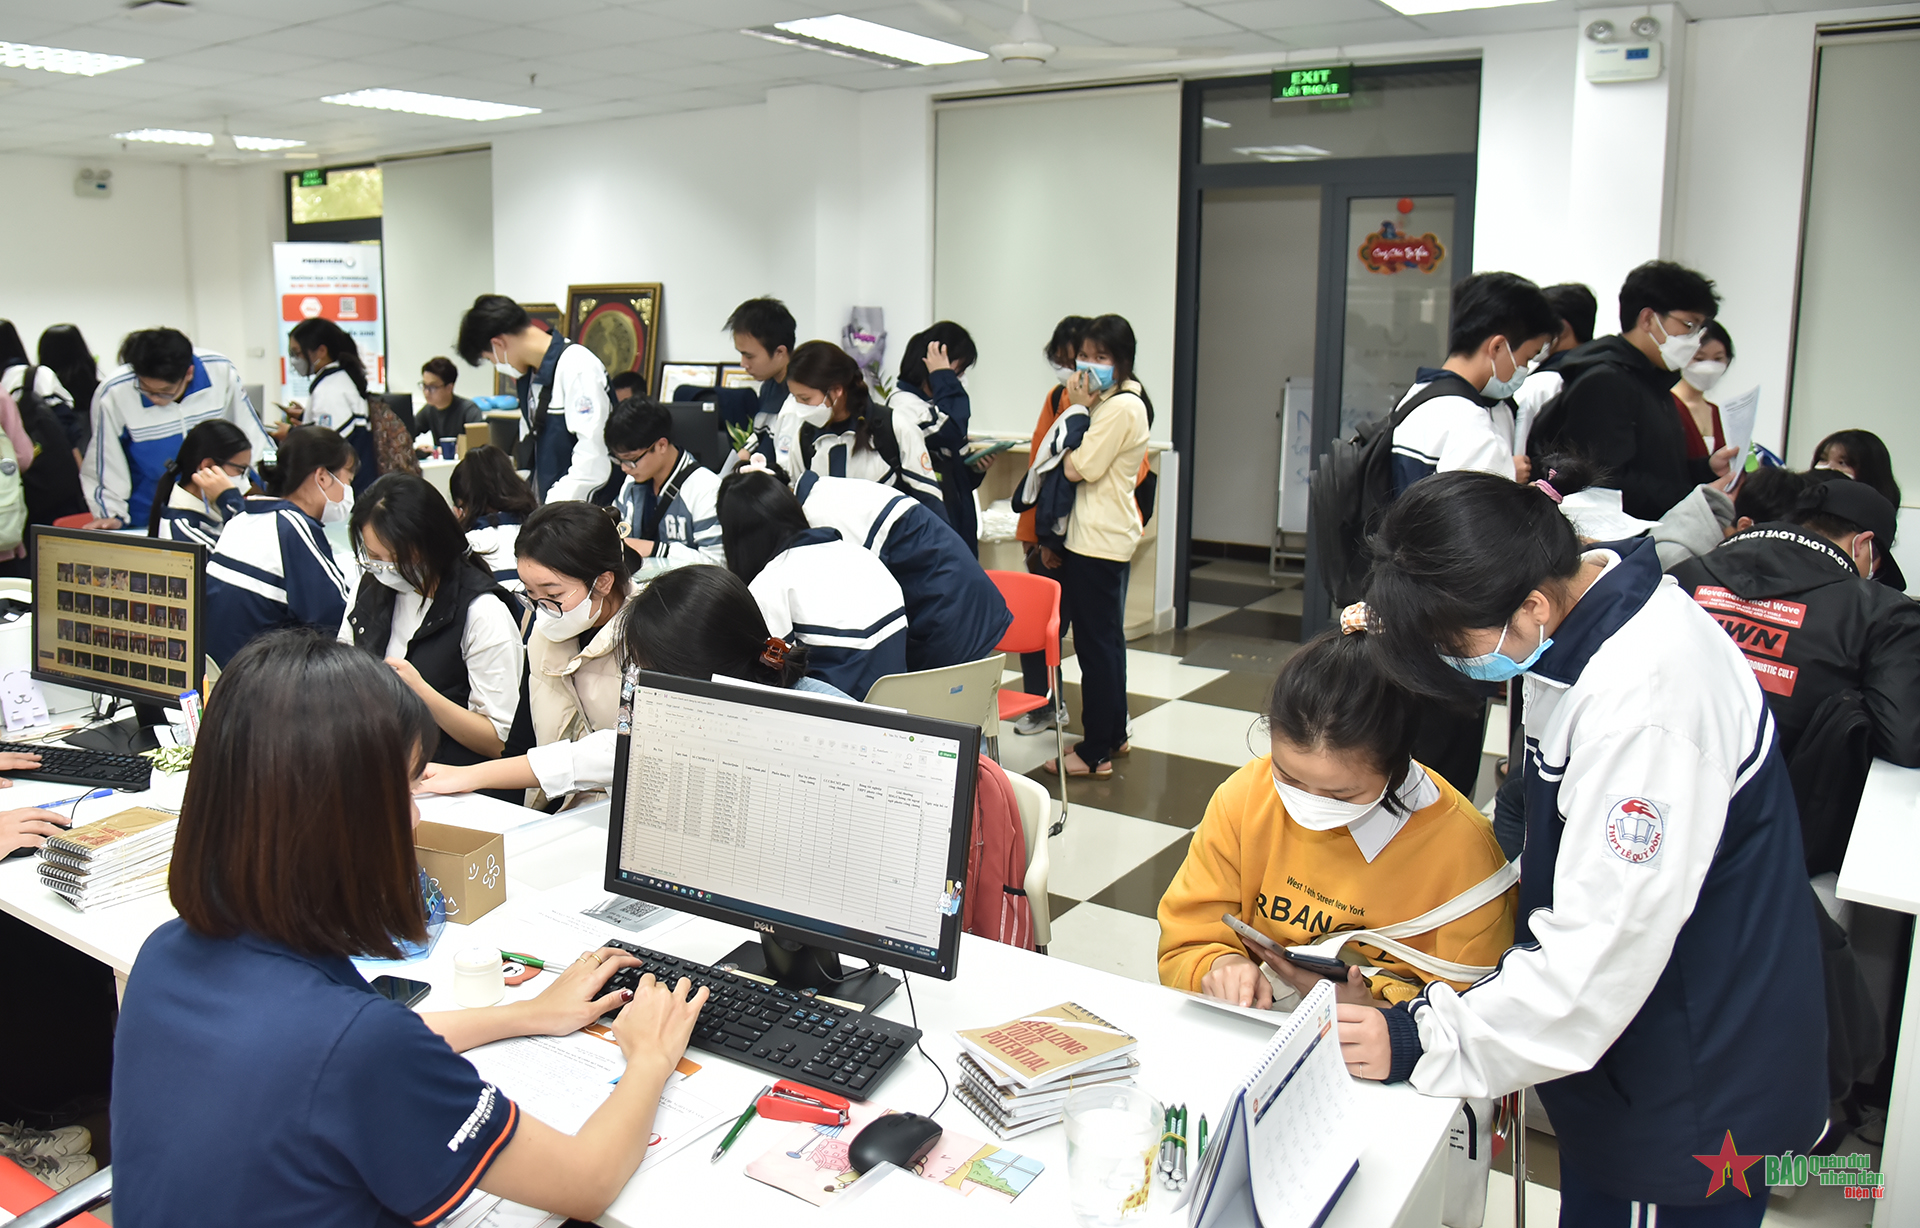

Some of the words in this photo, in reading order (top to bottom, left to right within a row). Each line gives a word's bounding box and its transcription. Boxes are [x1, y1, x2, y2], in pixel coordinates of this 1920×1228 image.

[1290, 69, 1332, 85] EXIT
[1766, 529, 1796, 542] LOVE
[1797, 534, 1826, 553] LOVE
[1827, 547, 1849, 570] LOVE
[1773, 602, 1801, 615] Wave
[1717, 619, 1782, 650] WN
[1748, 659, 1777, 676] DONISTIC
[1778, 667, 1795, 680] CULT
[1608, 824, 1622, 850] THPT
[1620, 848, 1632, 859] LÊ
[1286, 875, 1303, 891] West
[1303, 885, 1316, 899] 14th
[1316, 892, 1334, 907] Street
[1335, 899, 1348, 911] New
[1348, 904, 1365, 917] York
[1256, 892, 1355, 934] RBAN
[753, 920, 775, 934] DELL
[1001, 1023, 1043, 1047] YOUR
[1020, 1018, 1088, 1056] REALIZING
[981, 1030, 1050, 1072] POTENTIAL
[468, 1093, 497, 1140] UNIVERSITY
